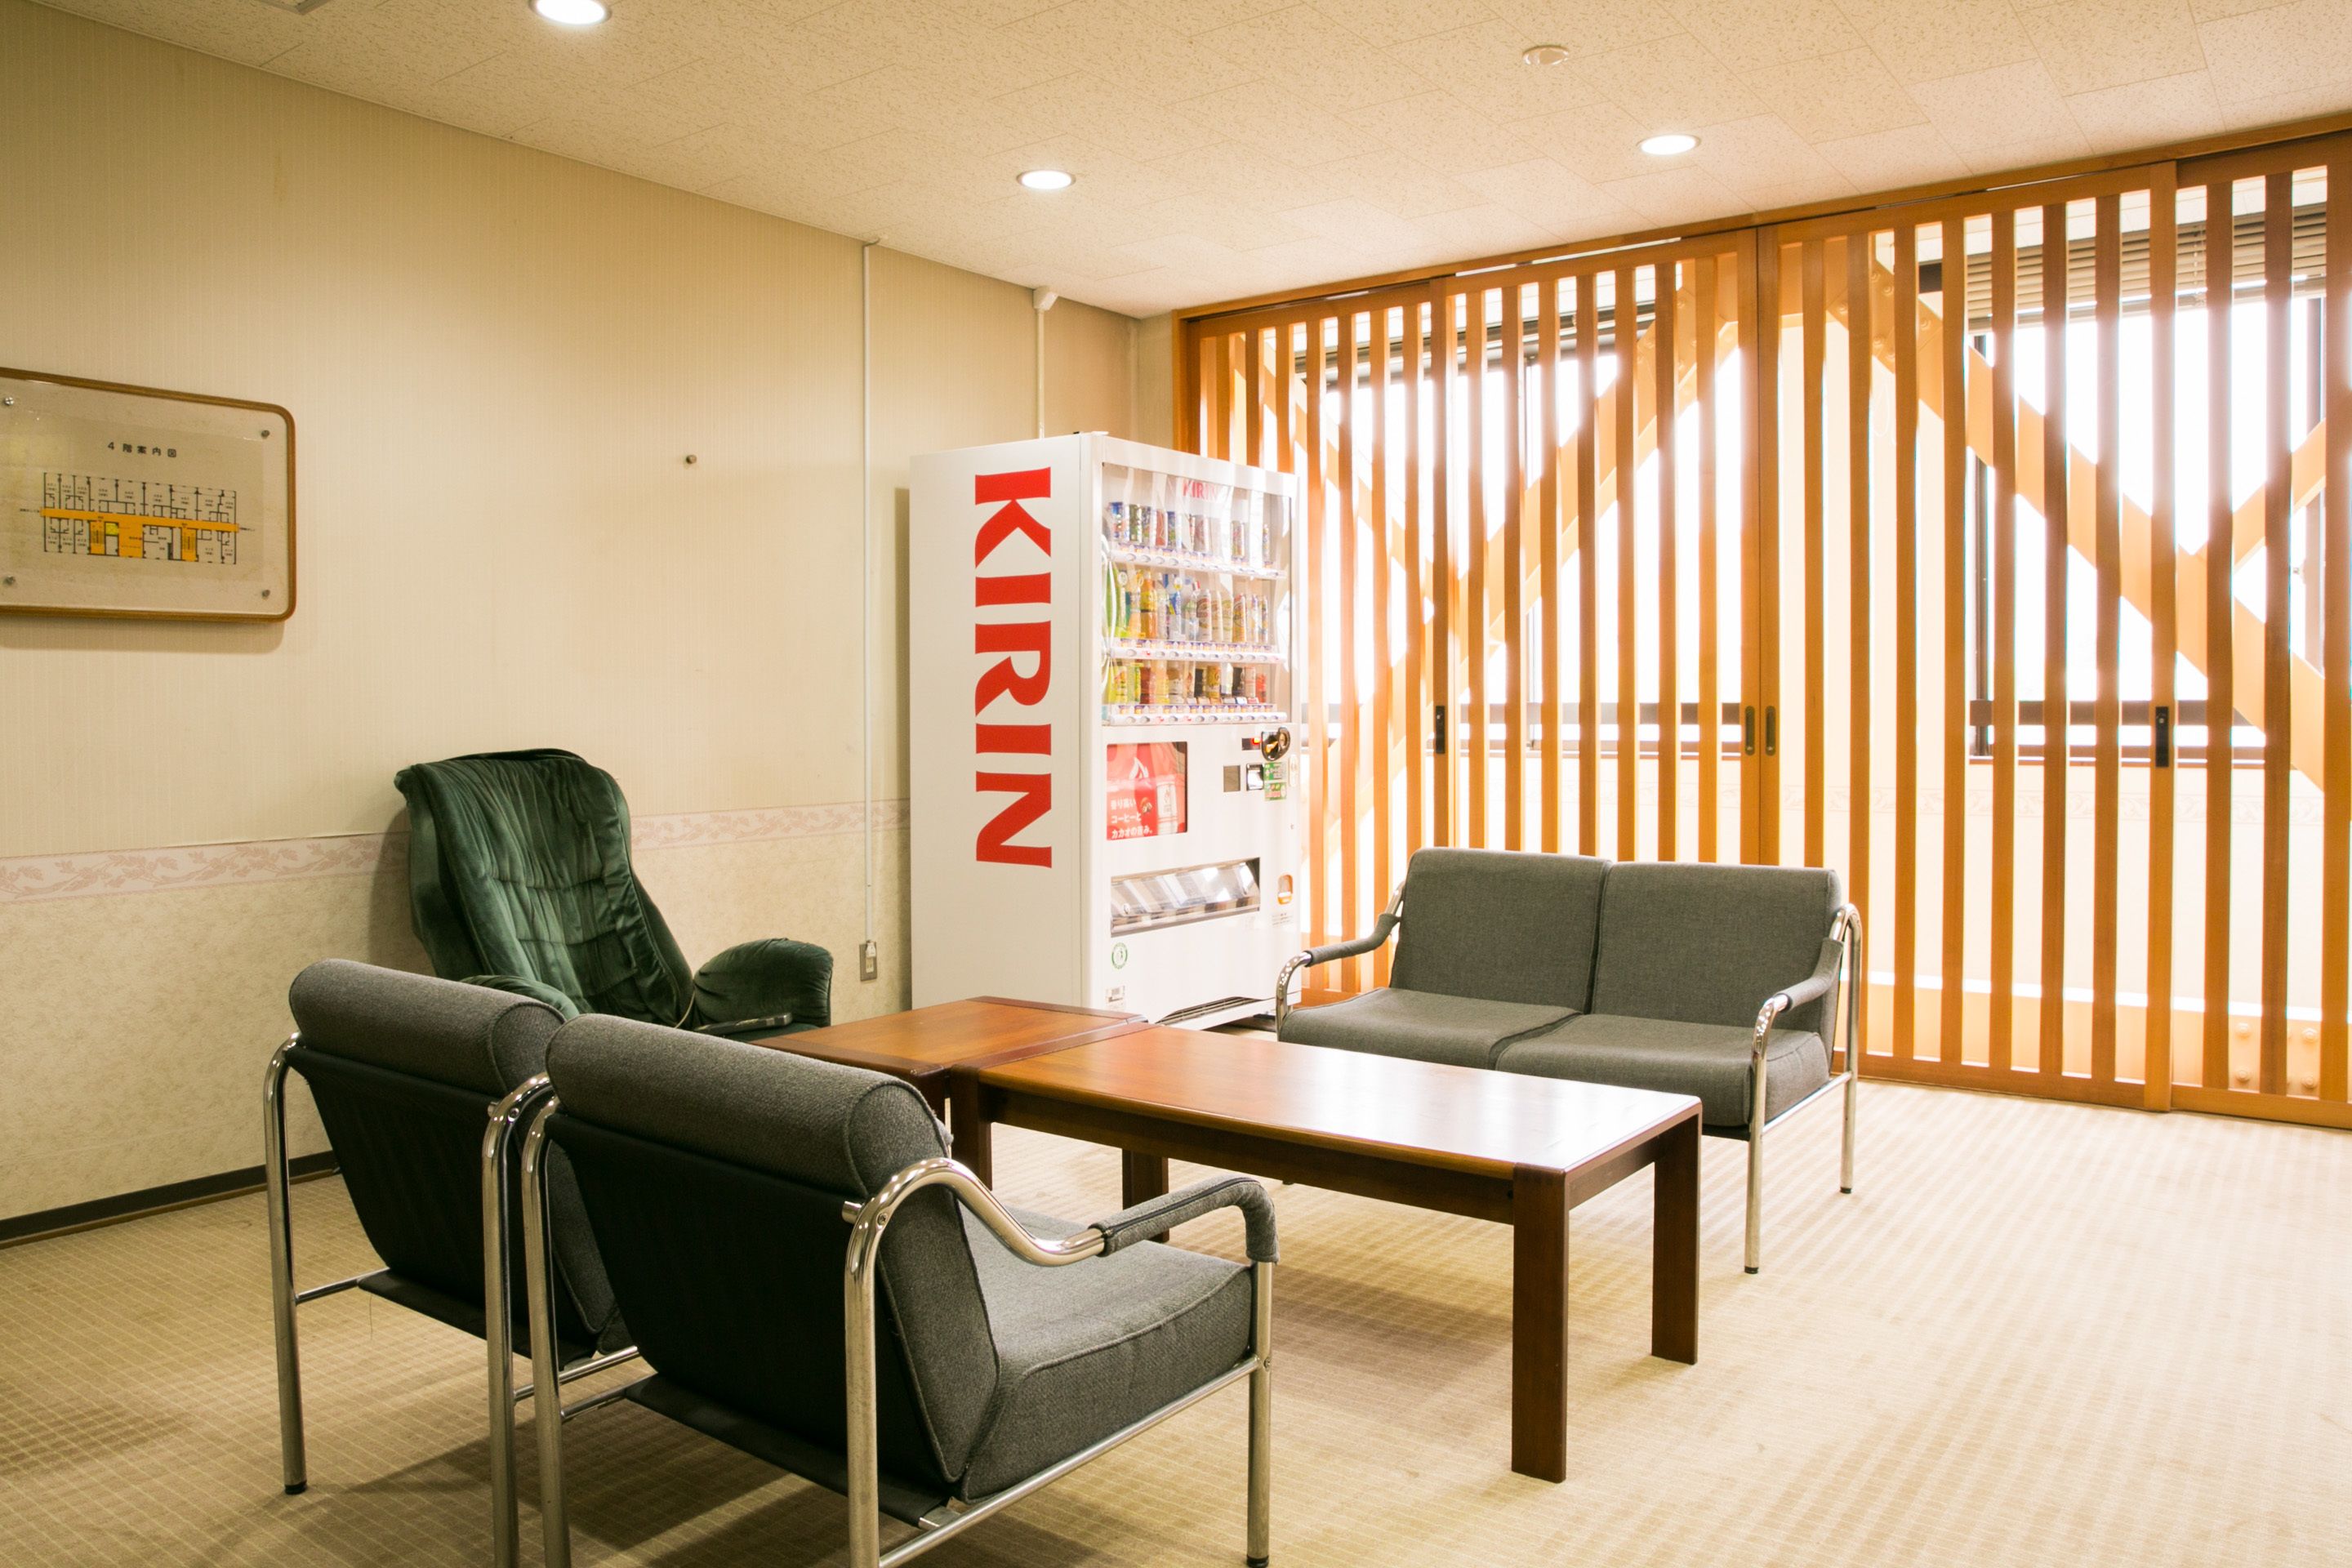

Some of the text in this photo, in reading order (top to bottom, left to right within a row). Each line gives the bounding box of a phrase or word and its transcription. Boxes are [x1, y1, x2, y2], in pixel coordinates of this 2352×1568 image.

[975, 466, 1052, 868] KIRIN
[1111, 812, 1142, 824] コーヒーと
